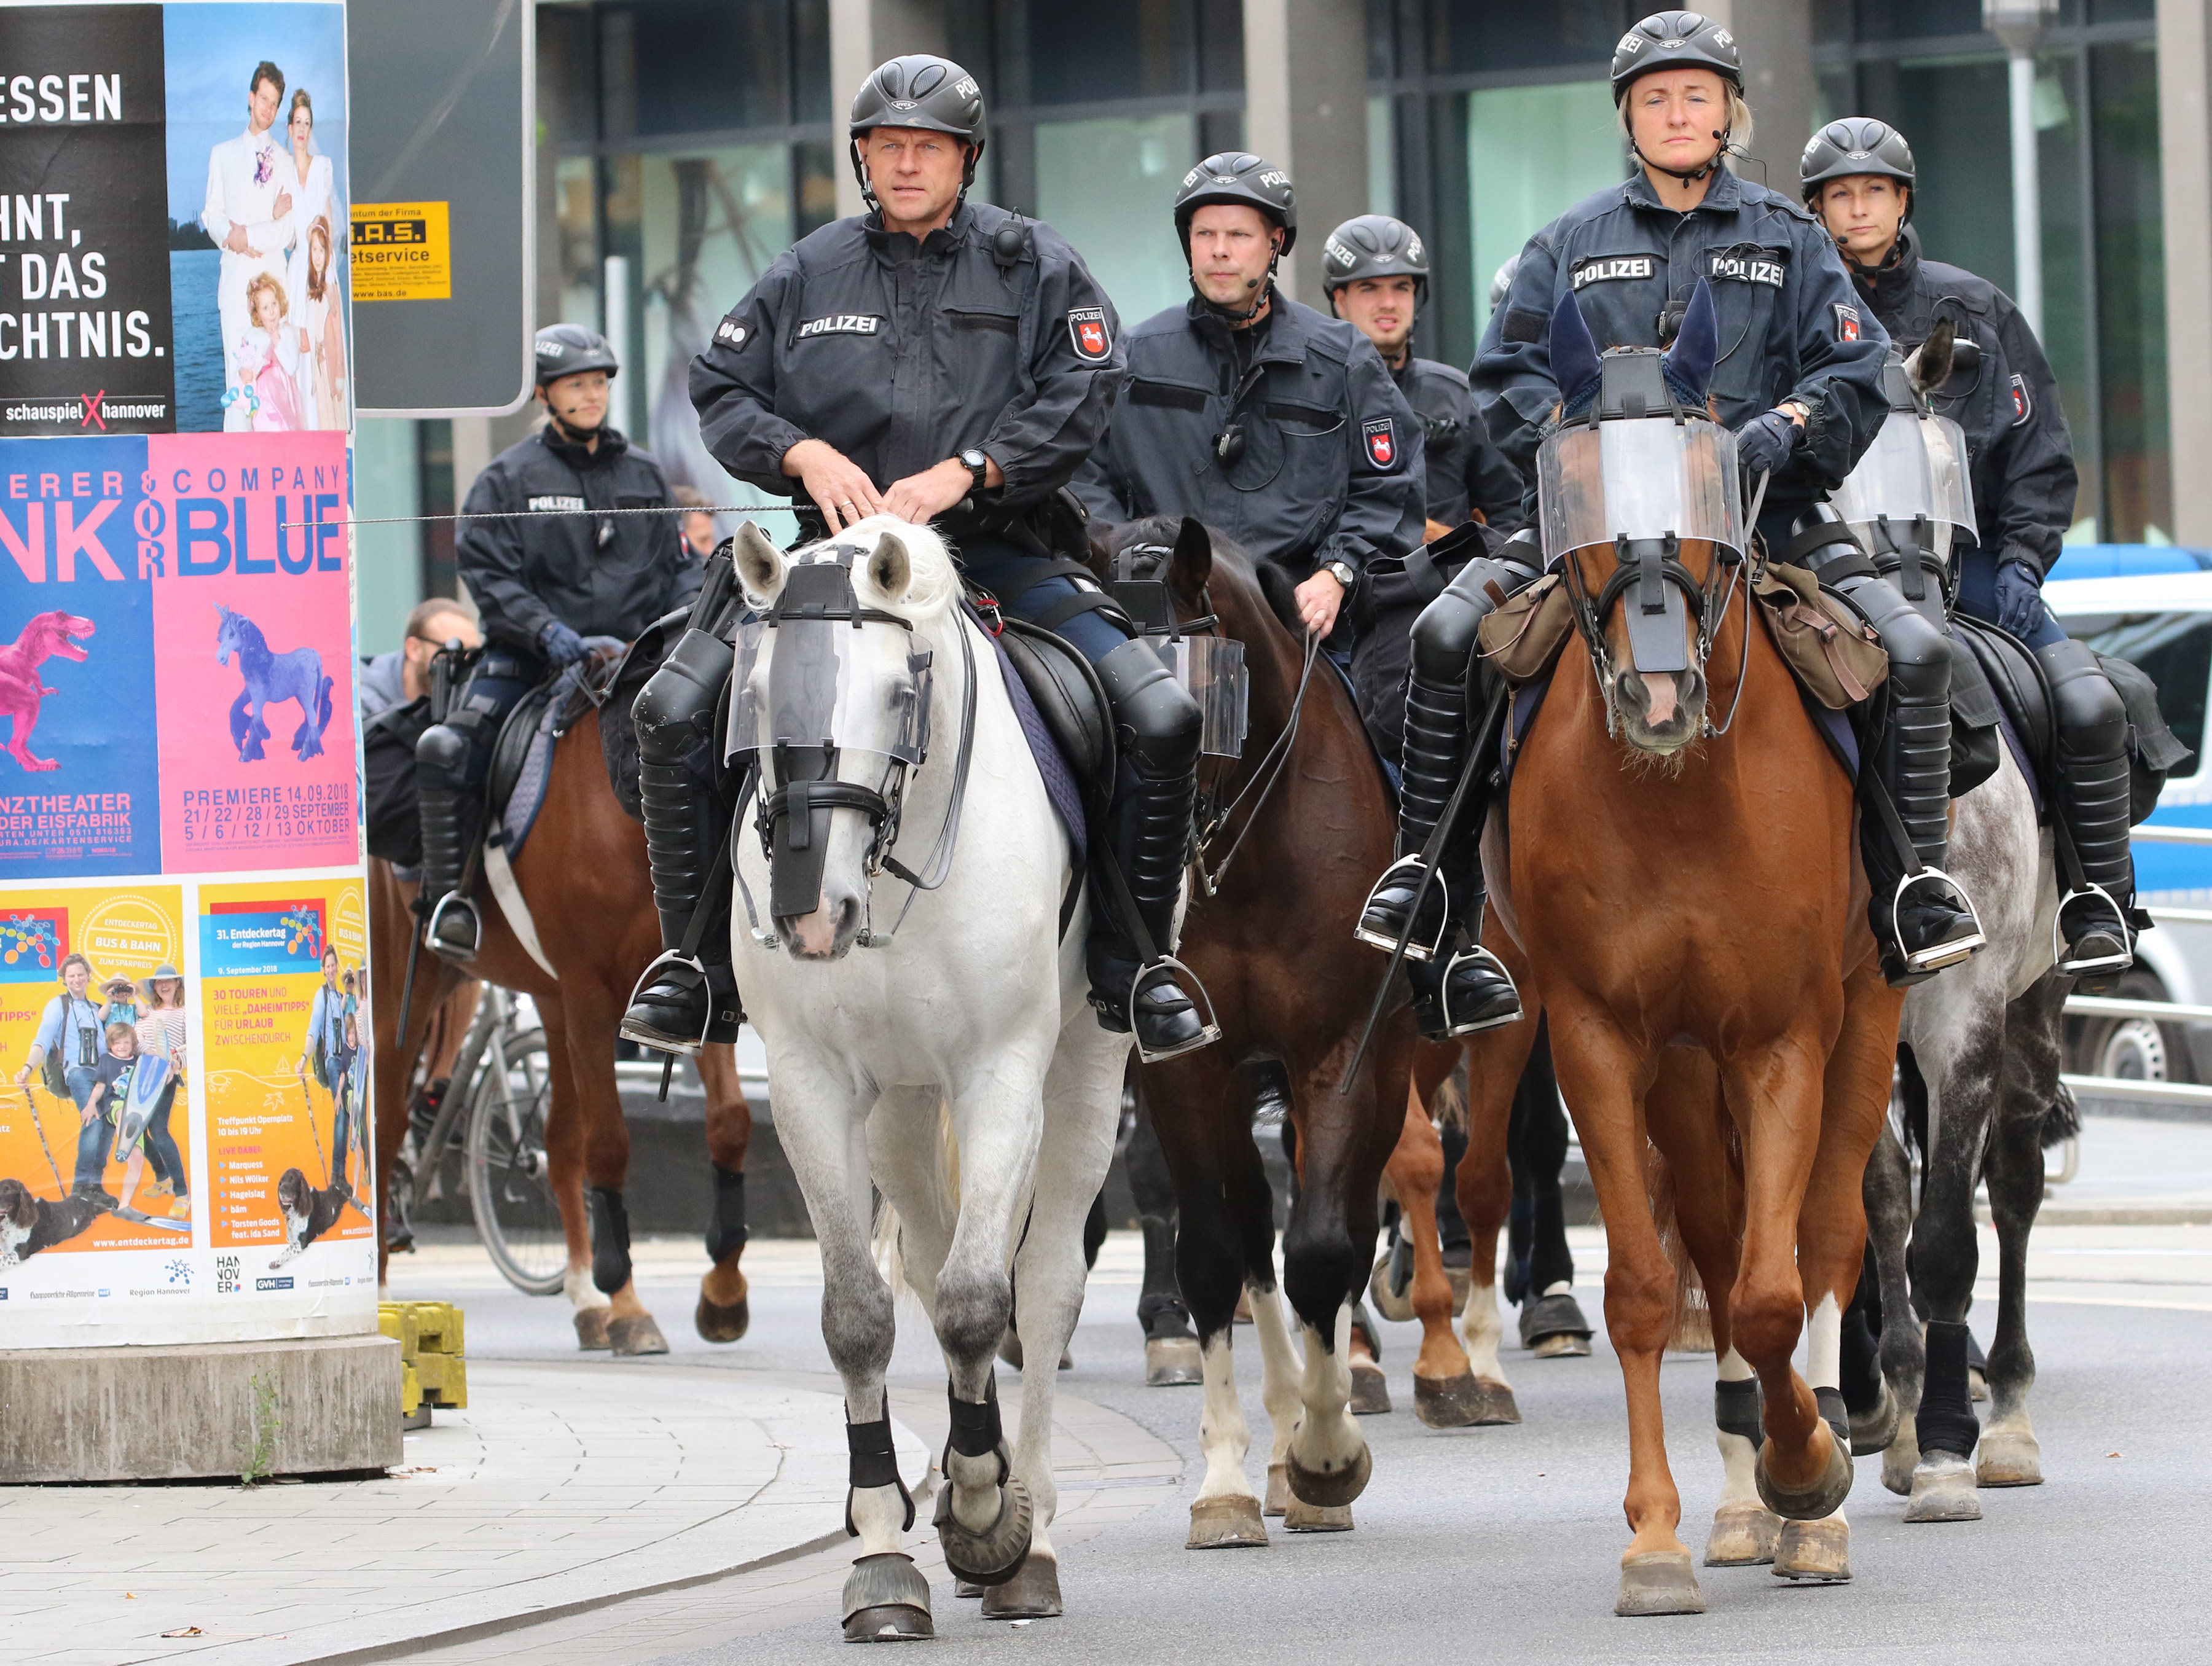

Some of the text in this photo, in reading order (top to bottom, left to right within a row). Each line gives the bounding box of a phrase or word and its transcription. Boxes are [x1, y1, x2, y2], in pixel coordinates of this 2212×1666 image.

[350, 209, 375, 218] ntum
[351, 222, 422, 243] .A.S.
[20, 251, 107, 300] DAS
[1574, 258, 1651, 289] POLIZEI
[1712, 257, 1784, 287] POLIZEI
[353, 289, 407, 298] www.bas.de
[1070, 311, 1102, 322] POLIZEI
[799, 315, 877, 337] POLIZEI
[0, 310, 165, 361] CHTNIS.
[1365, 422, 1390, 434] POLIZEI
[10, 471, 124, 499] ERER
[141, 470, 157, 493] &
[173, 464, 339, 494] COMPANY
[528, 496, 585, 510] POLIZEI
[176, 493, 342, 577] BLUE
[183, 783, 349, 807] PREMIERE 14.09.2018
[184, 808, 200, 823] 21
[214, 807, 232, 822] 22
[246, 807, 262, 821] 28
[274, 805, 289, 819] 29
[292, 801, 350, 819] SEPTEMBER
[37, 812, 131, 829] EISFABRIK
[184, 826, 194, 840] 5
[215, 824, 224, 839] 6
[244, 823, 260, 837] 12
[276, 822, 292, 836] 13
[296, 818, 350, 835] OKTOBER
[104, 918, 158, 930] ENTDECKERTAG
[216, 927, 286, 941] 31. Entdeckertag
[95, 937, 161, 952] BUS & BAHN
[98, 957, 153, 969] ZUM SPARPREIS
[226, 966, 262, 976] September
[213, 987, 287, 1000] 30 TOUREN UND
[213, 1004, 240, 1015] VIELE
[214, 1017, 273, 1030] FÜR URLAUB
[214, 1031, 291, 1046] ZWISCHENDURCH
[217, 1114, 294, 1126] Treffpunkt Opernplatz
[227, 1127, 239, 1136] bis
[249, 1126, 262, 1135] Uhr
[218, 1147, 236, 1156] LIVE
[229, 1161, 263, 1171] Marquess
[230, 1175, 269, 1184] Nils Wülker
[230, 1189, 265, 1200] Hagelslag
[230, 1205, 247, 1214] bäm
[231, 1218, 280, 1228] Torsten Goods
[231, 1229, 280, 1239] feat. Ida Sand
[92, 1235, 189, 1248] www.entdeckertag.de
[217, 1256, 240, 1268] HAN
[217, 1269, 240, 1280] NOV
[218, 1281, 233, 1293] ER
[257, 1280, 275, 1289] GVH
[129, 1289, 155, 1298] Region
